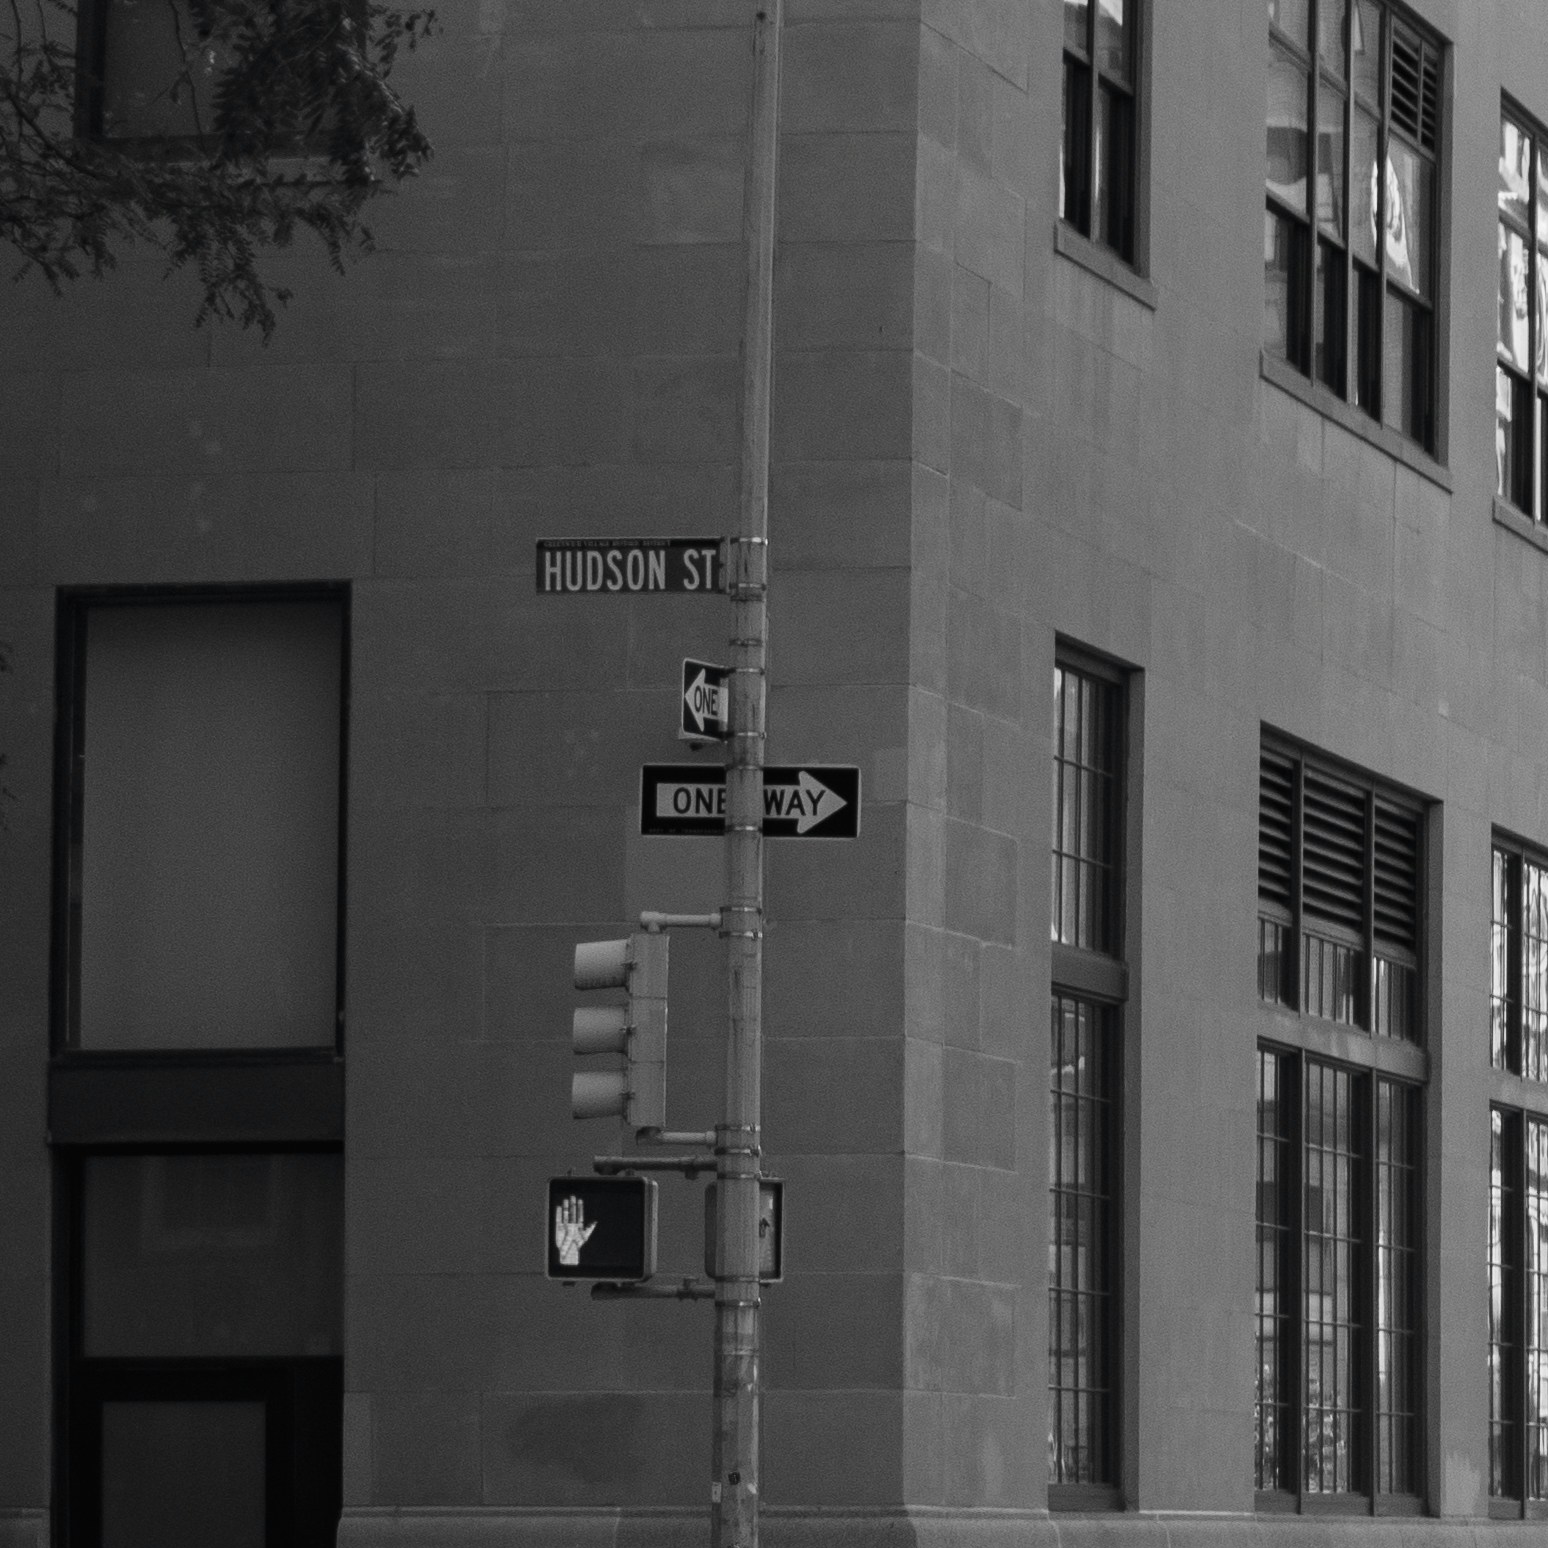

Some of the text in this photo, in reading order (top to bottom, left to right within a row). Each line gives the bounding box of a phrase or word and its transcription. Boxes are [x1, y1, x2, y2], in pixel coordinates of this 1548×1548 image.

[545, 549, 716, 591] HUDSON ST
[694, 685, 719, 716] ONE
[673, 787, 826, 817] ONE WAY
